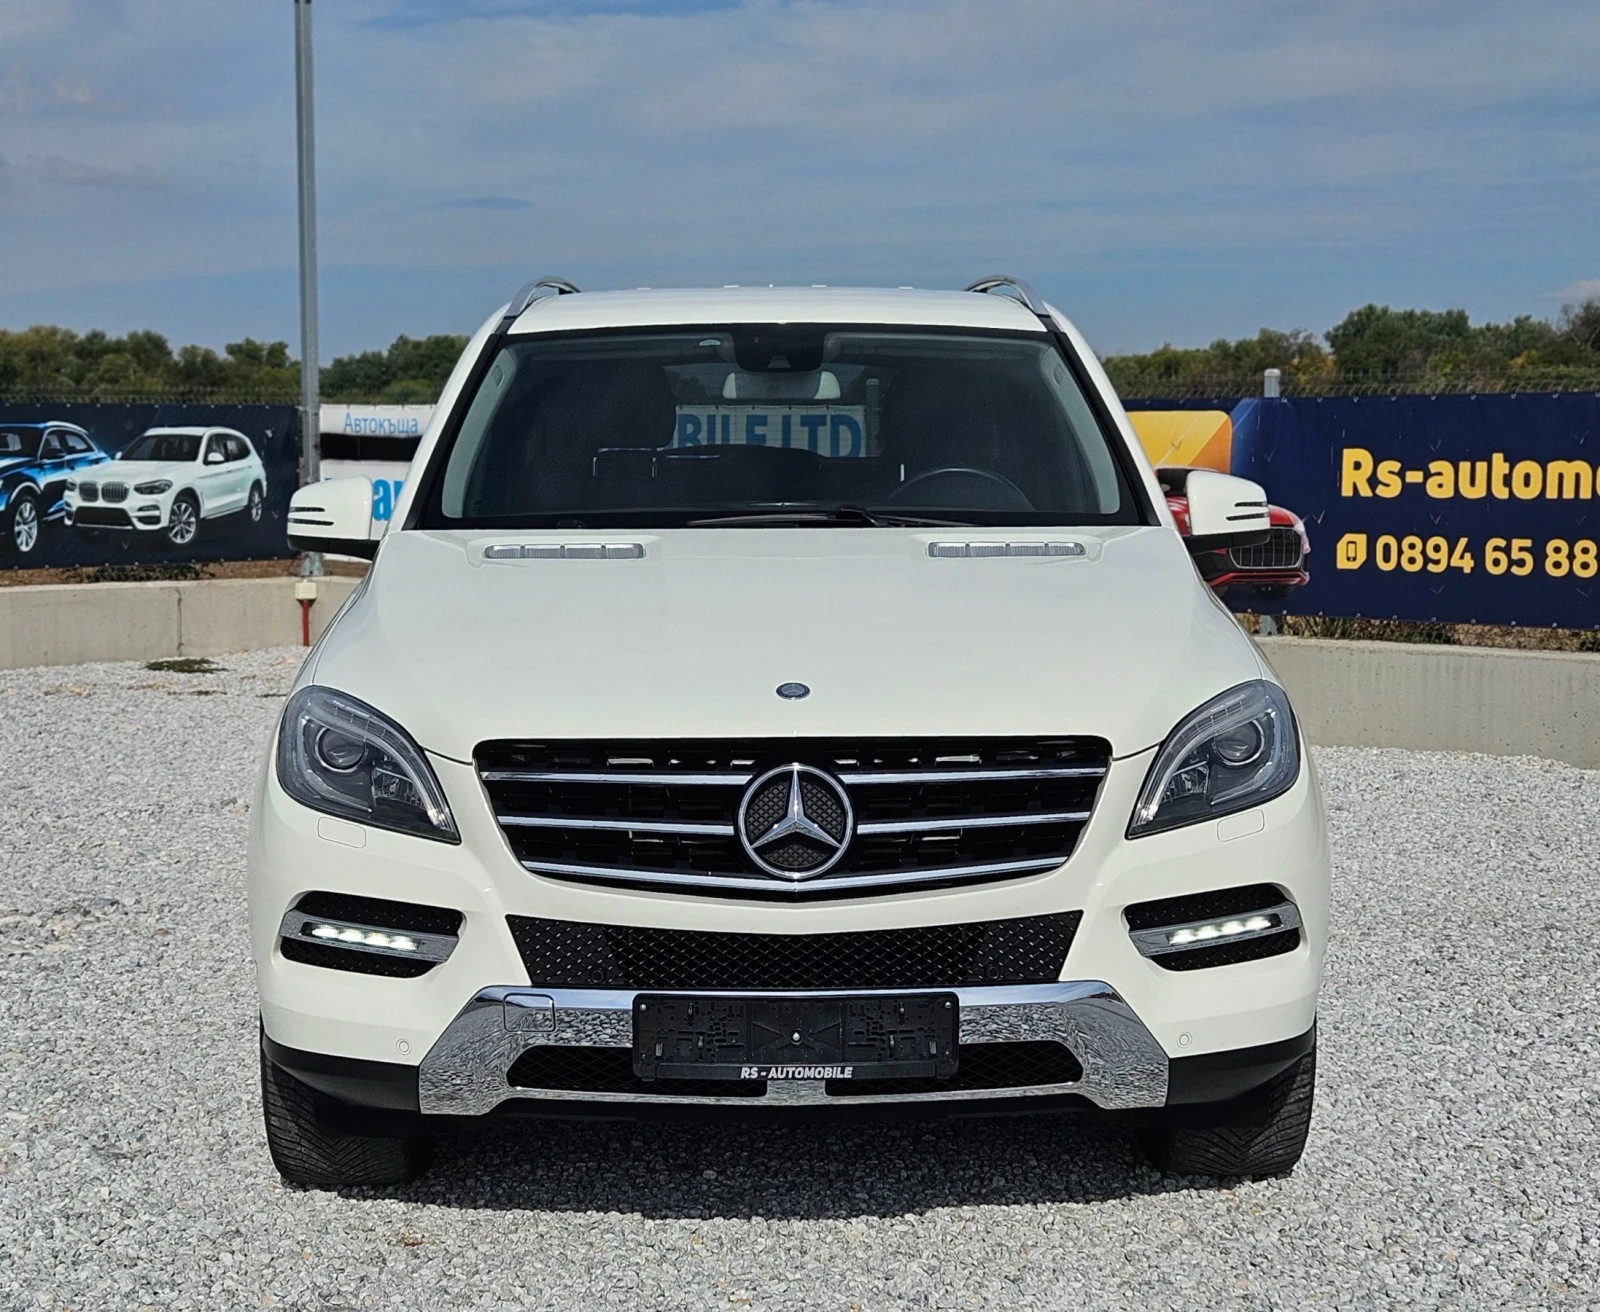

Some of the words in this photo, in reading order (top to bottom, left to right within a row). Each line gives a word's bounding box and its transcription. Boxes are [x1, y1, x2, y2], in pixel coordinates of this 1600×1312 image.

[344, 412, 419, 434] Автокъща
[1341, 447, 1600, 499] Rs-autom
[1376, 534, 1475, 574] 0894
[1485, 537, 1534, 576] 65
[1544, 538, 1599, 578] 88
